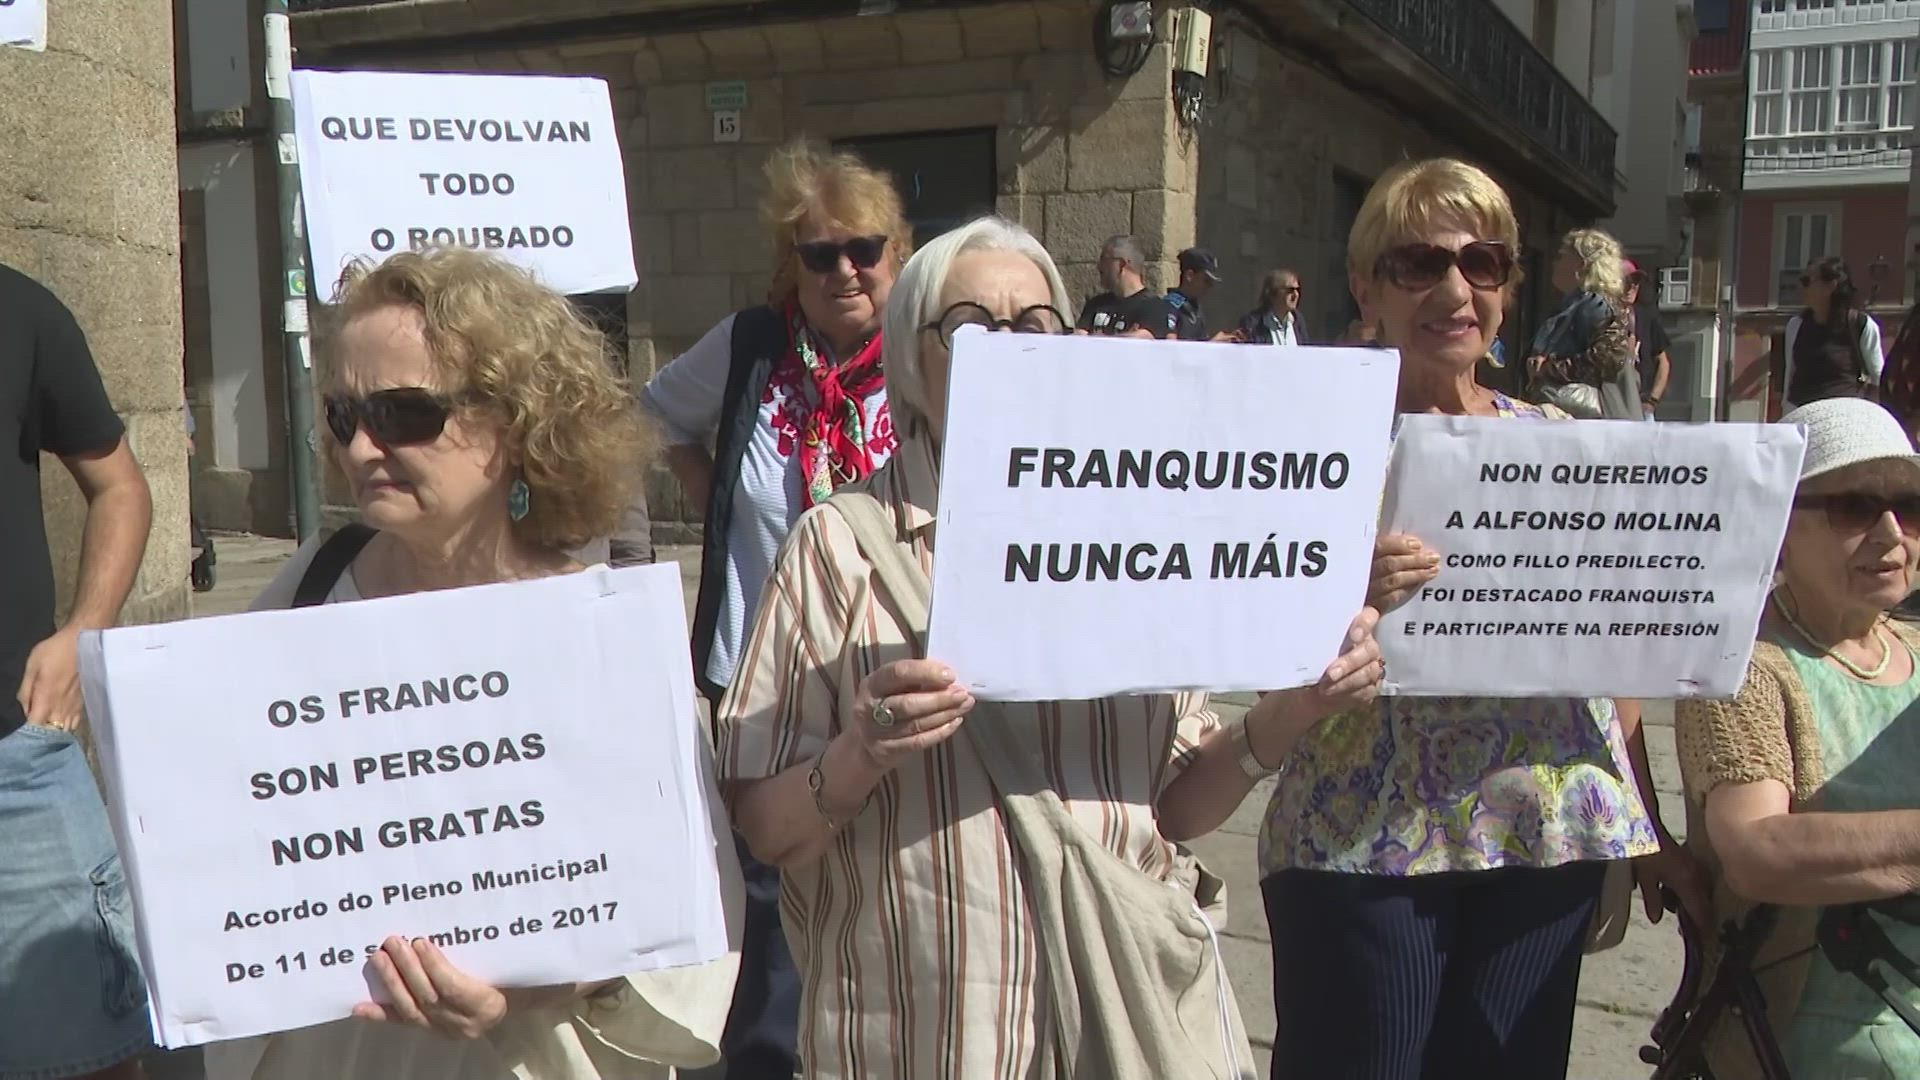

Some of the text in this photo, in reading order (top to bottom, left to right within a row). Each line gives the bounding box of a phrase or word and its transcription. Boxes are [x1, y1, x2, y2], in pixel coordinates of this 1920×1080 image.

[321, 117, 591, 142] QUE DEVOLVAN
[419, 173, 514, 196] TODO
[371, 225, 573, 251] O ROUBADO
[1008, 447, 1349, 492] FRANQUISMO
[1480, 463, 1708, 485] NON QUEREMOS
[1445, 510, 1721, 532] A ALFONSO MOLINA
[1004, 532, 1328, 582] NUNCA MÁIS
[1447, 554, 1704, 570] COMO FILLO PREDILECTO.
[1422, 588, 1714, 603] FOI DESTACADO FRANQUISTA
[1404, 622, 1719, 636] E PARTICIPANTE NA REPRESIÓN
[268, 671, 509, 728] OS FRANCO
[251, 733, 545, 800] SON PERSOAS
[272, 800, 544, 866] NON GRATAS
[224, 853, 607, 931] Acordo do Pleno Municipal
[226, 963, 264, 983] De
[276, 952, 306, 973] 11
[320, 947, 354, 967] de
[509, 916, 543, 936] de
[552, 902, 618, 929] 2017
